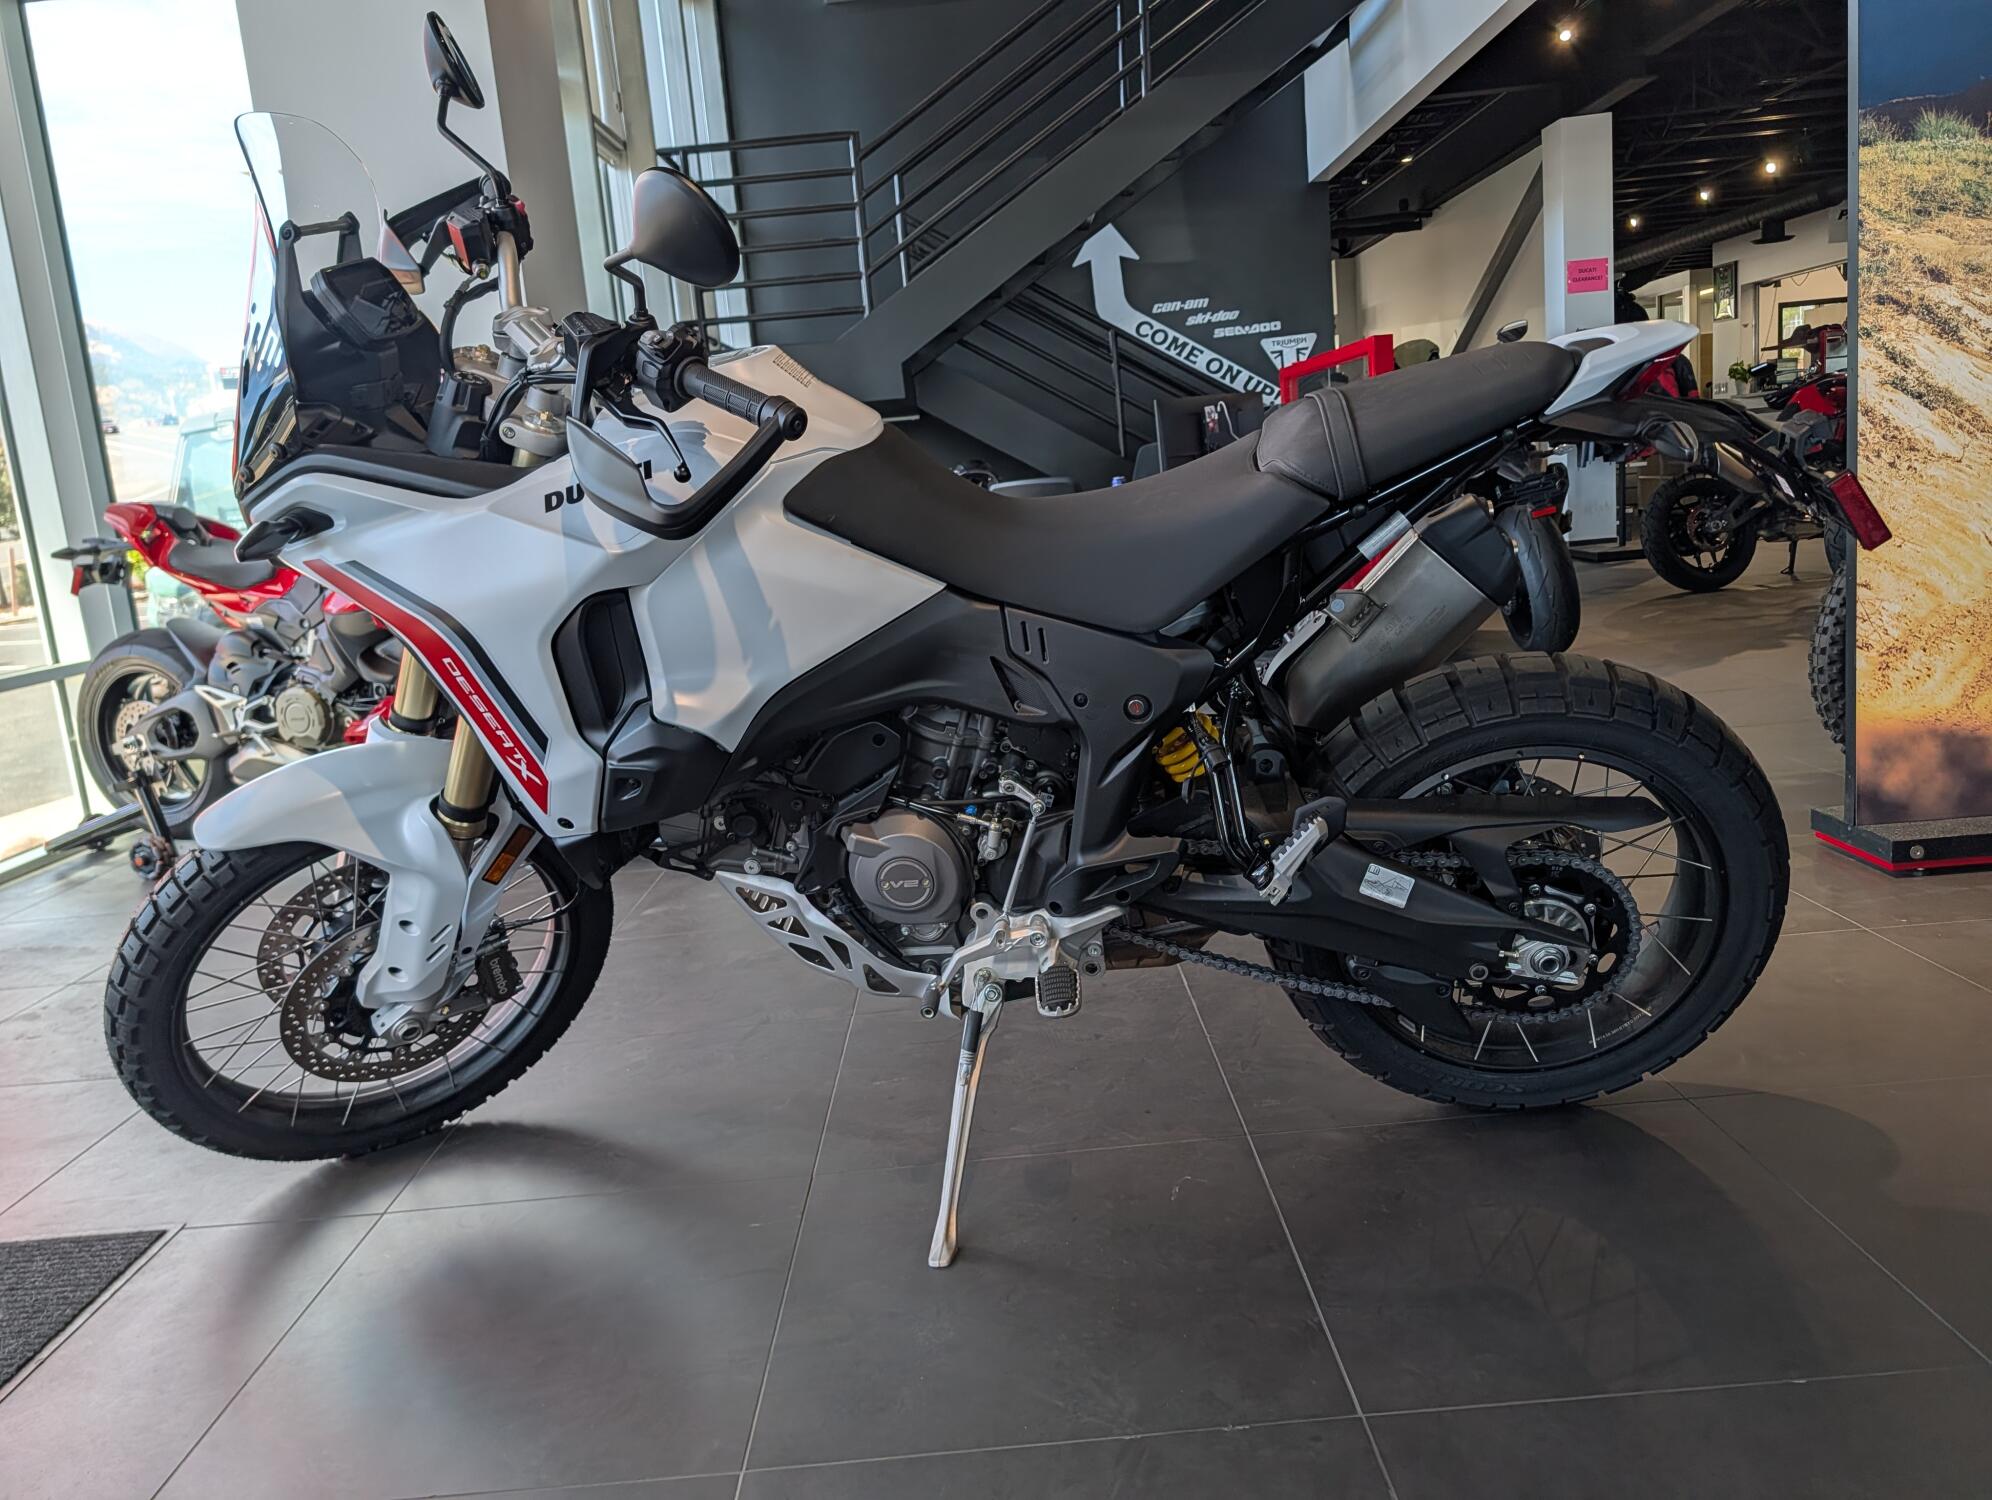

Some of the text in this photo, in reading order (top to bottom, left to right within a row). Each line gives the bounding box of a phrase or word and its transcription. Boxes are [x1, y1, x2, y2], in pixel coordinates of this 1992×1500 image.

[1152, 297, 1210, 314] can-am
[1185, 309, 1241, 326] ski-doo
[1271, 336, 1308, 347] TRIUMPH
[1135, 320, 1204, 365] COME
[1205, 357, 1242, 385] ON
[544, 458, 653, 514] DUI
[889, 879, 919, 889] V2
[489, 957, 508, 995] brembo
